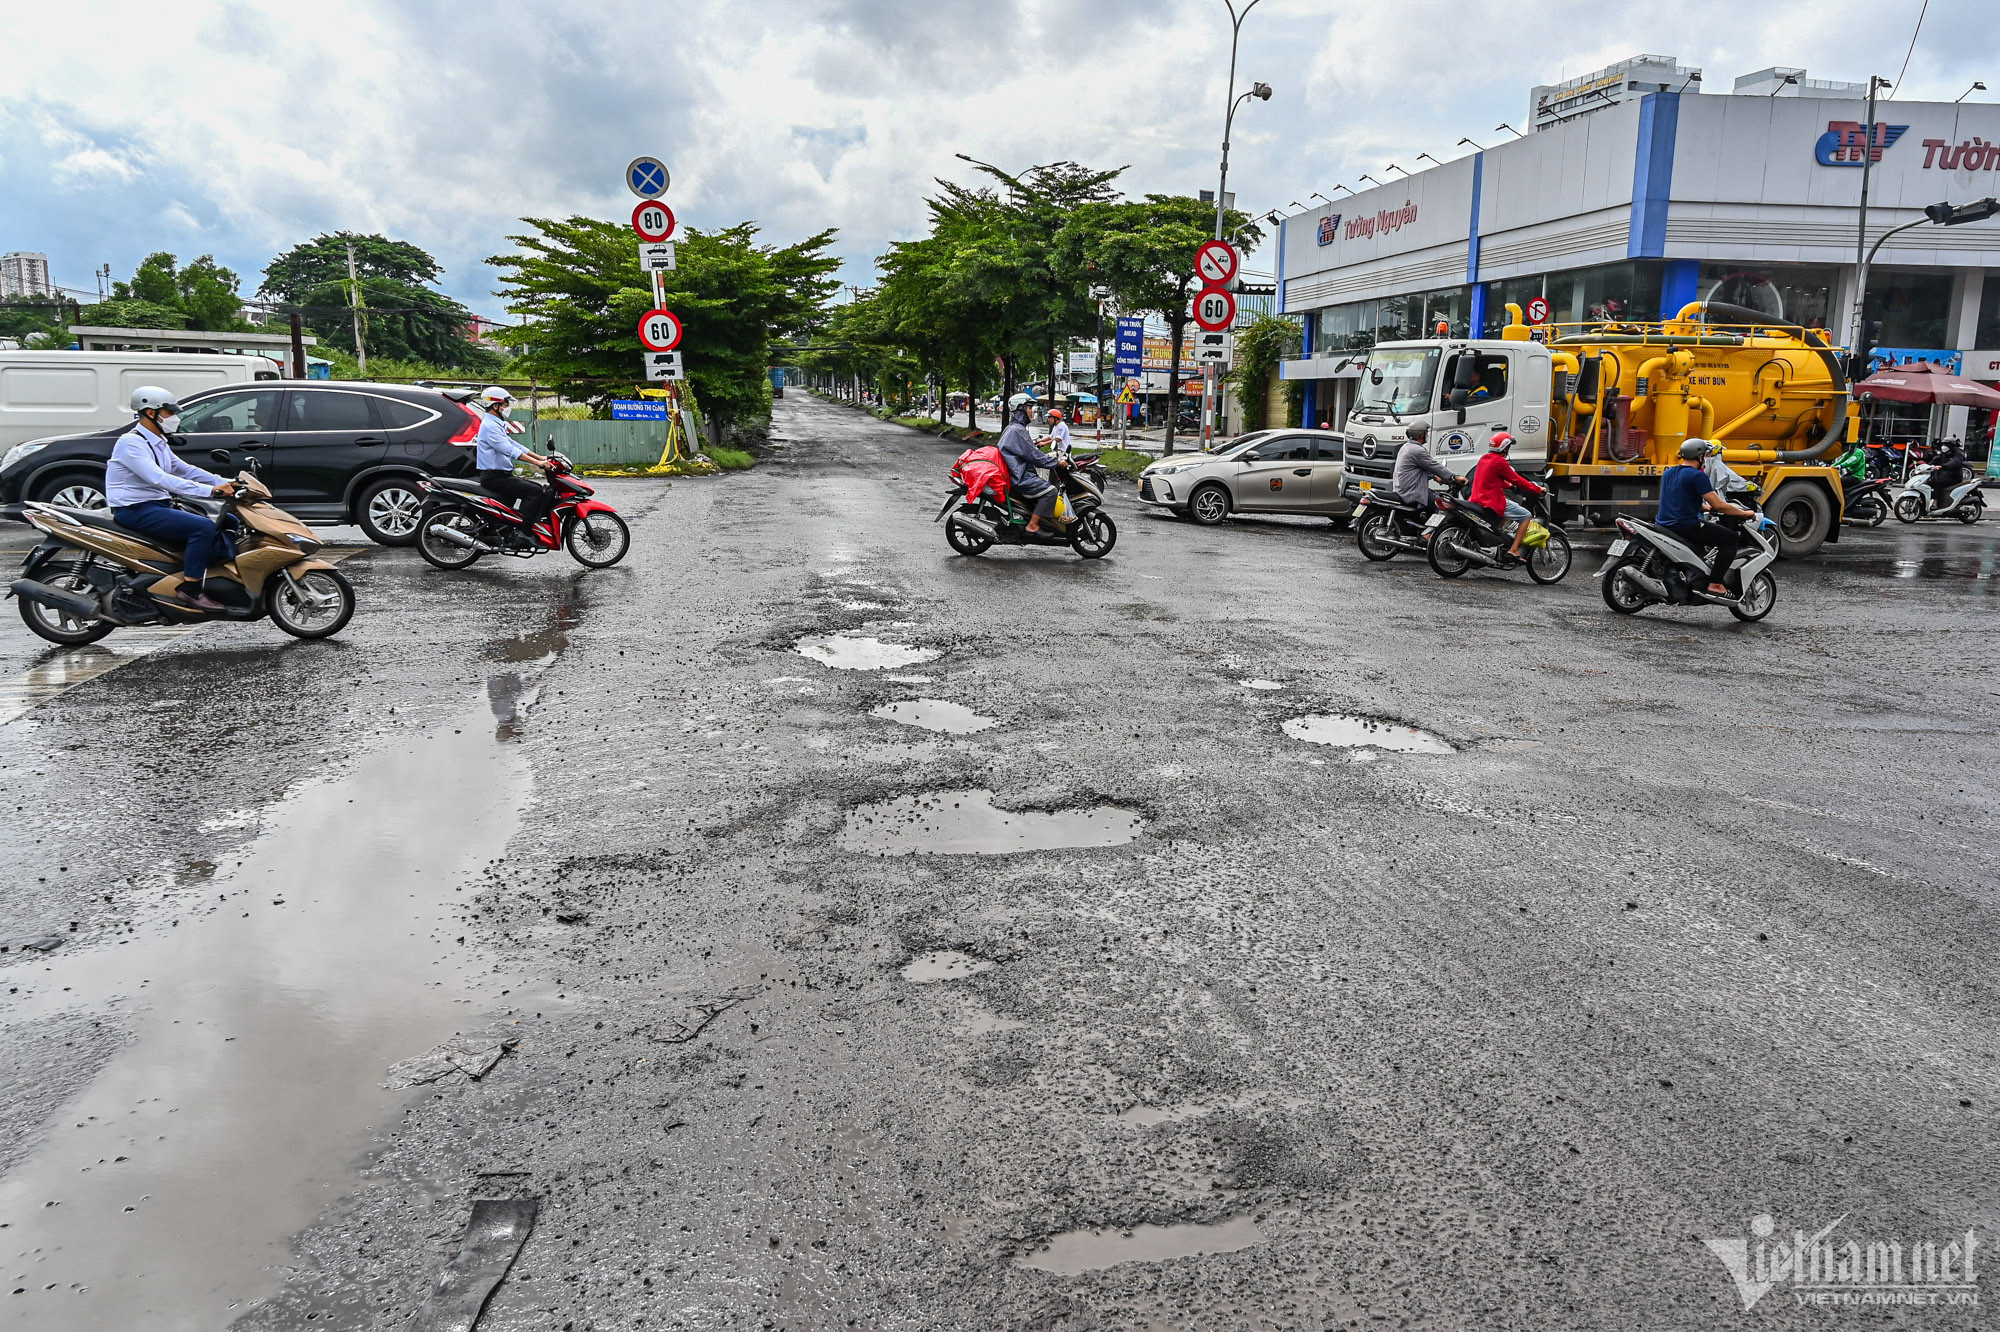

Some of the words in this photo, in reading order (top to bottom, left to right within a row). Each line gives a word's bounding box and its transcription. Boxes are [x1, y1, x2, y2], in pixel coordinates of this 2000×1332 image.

[643, 211, 663, 230] 80
[1344, 215, 1376, 241] Tường
[1376, 199, 1418, 236] Nguyên
[1204, 299, 1223, 318] 60
[651, 322, 670, 341] 60
[1121, 342, 1137, 351] 50m
[1116, 356, 1127, 364] CÔNG
[1689, 376, 1696, 385] XE
[1698, 374, 1711, 385] HÚT
[1712, 375, 1726, 386] BÙN
